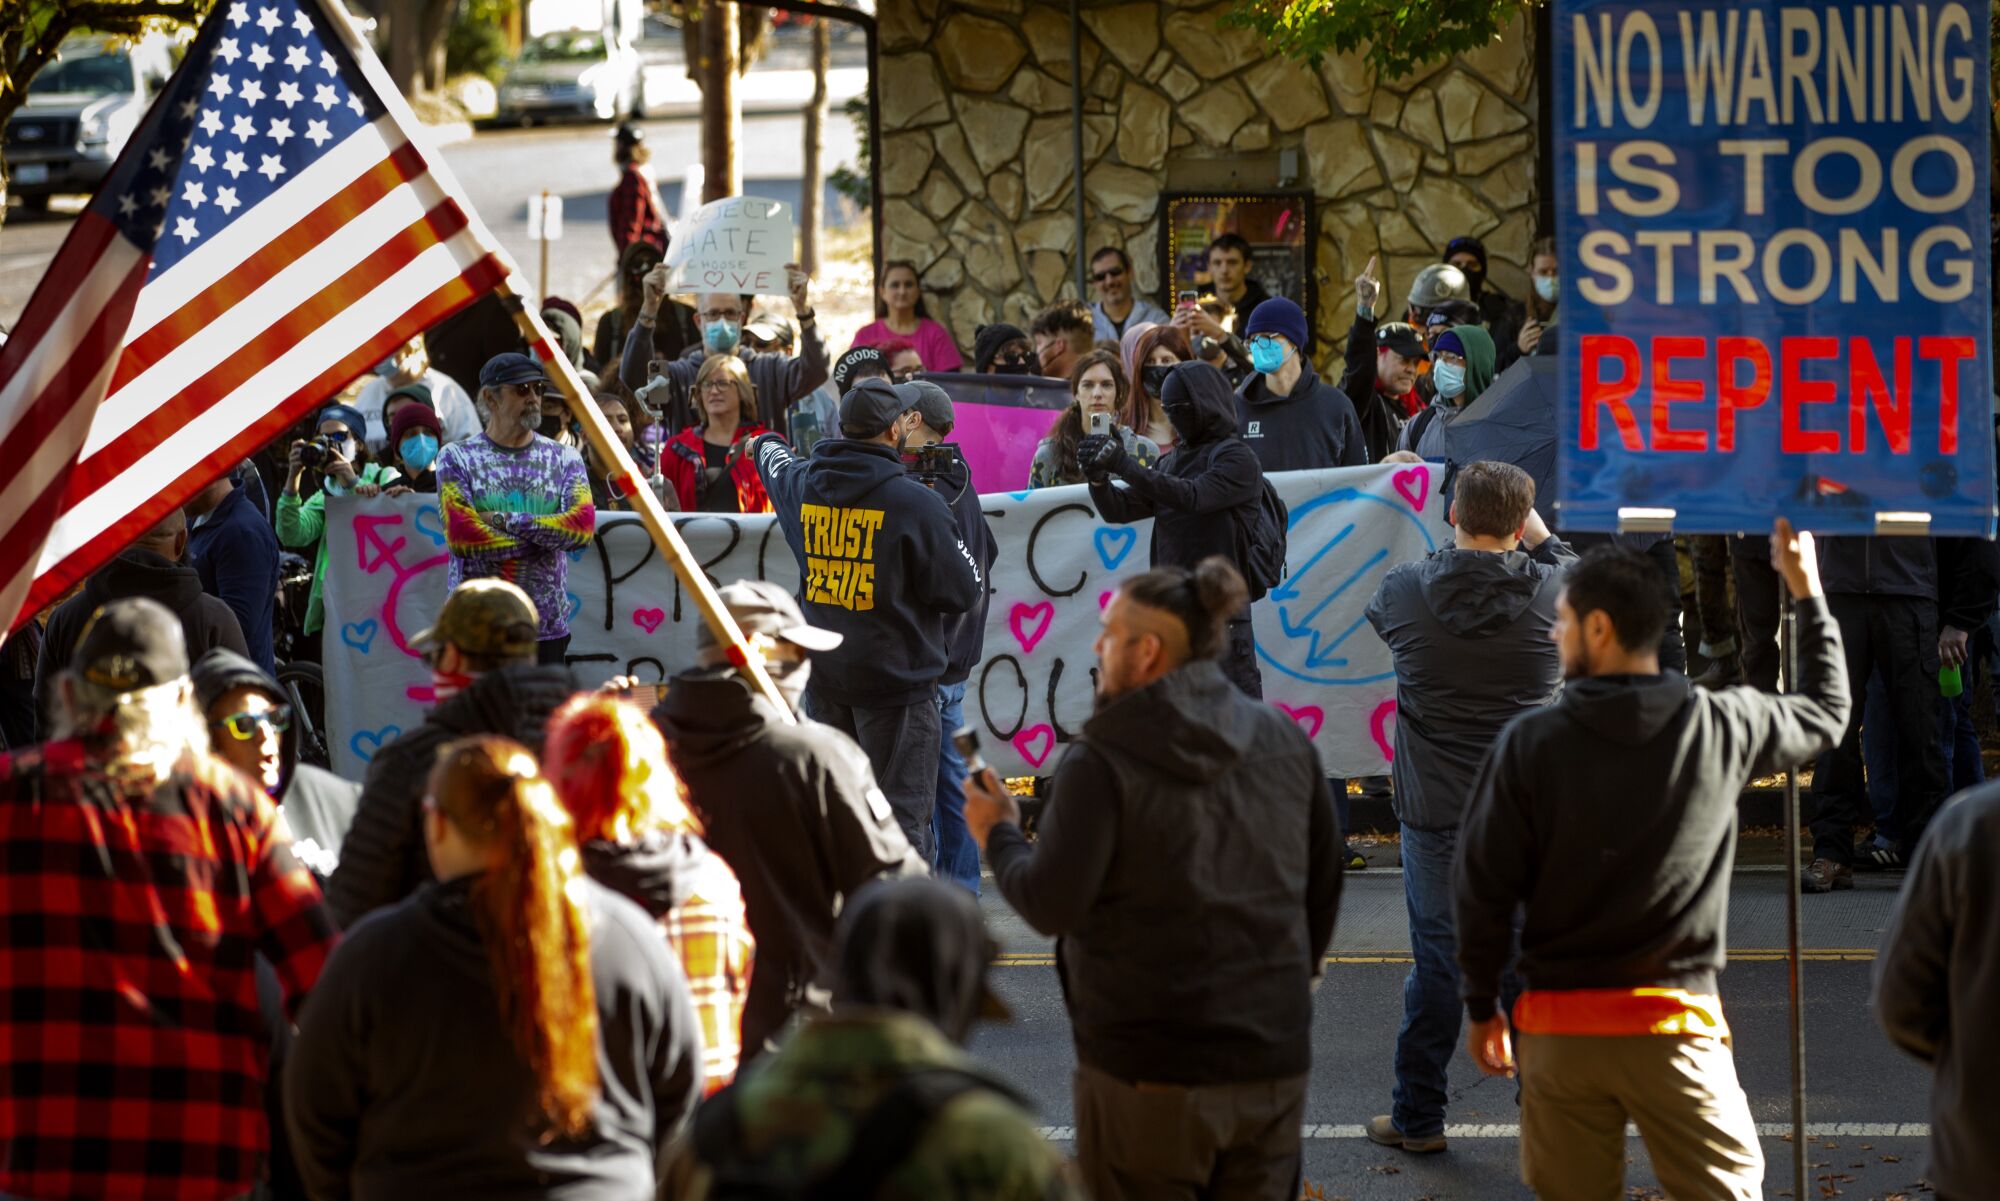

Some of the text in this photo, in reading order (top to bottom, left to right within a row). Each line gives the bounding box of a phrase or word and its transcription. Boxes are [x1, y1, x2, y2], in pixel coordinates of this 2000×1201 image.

[1573, 3, 1974, 128] NO WARNING
[1575, 135, 1975, 217] IS TOO
[681, 228, 768, 256] HATE
[687, 259, 748, 270] CHOOSE
[1576, 225, 1974, 306] STRONG
[835, 349, 880, 383] NO GODS
[1579, 334, 1976, 454] REPENT
[800, 503, 885, 560] TRUST
[806, 556, 875, 612] JESUS
